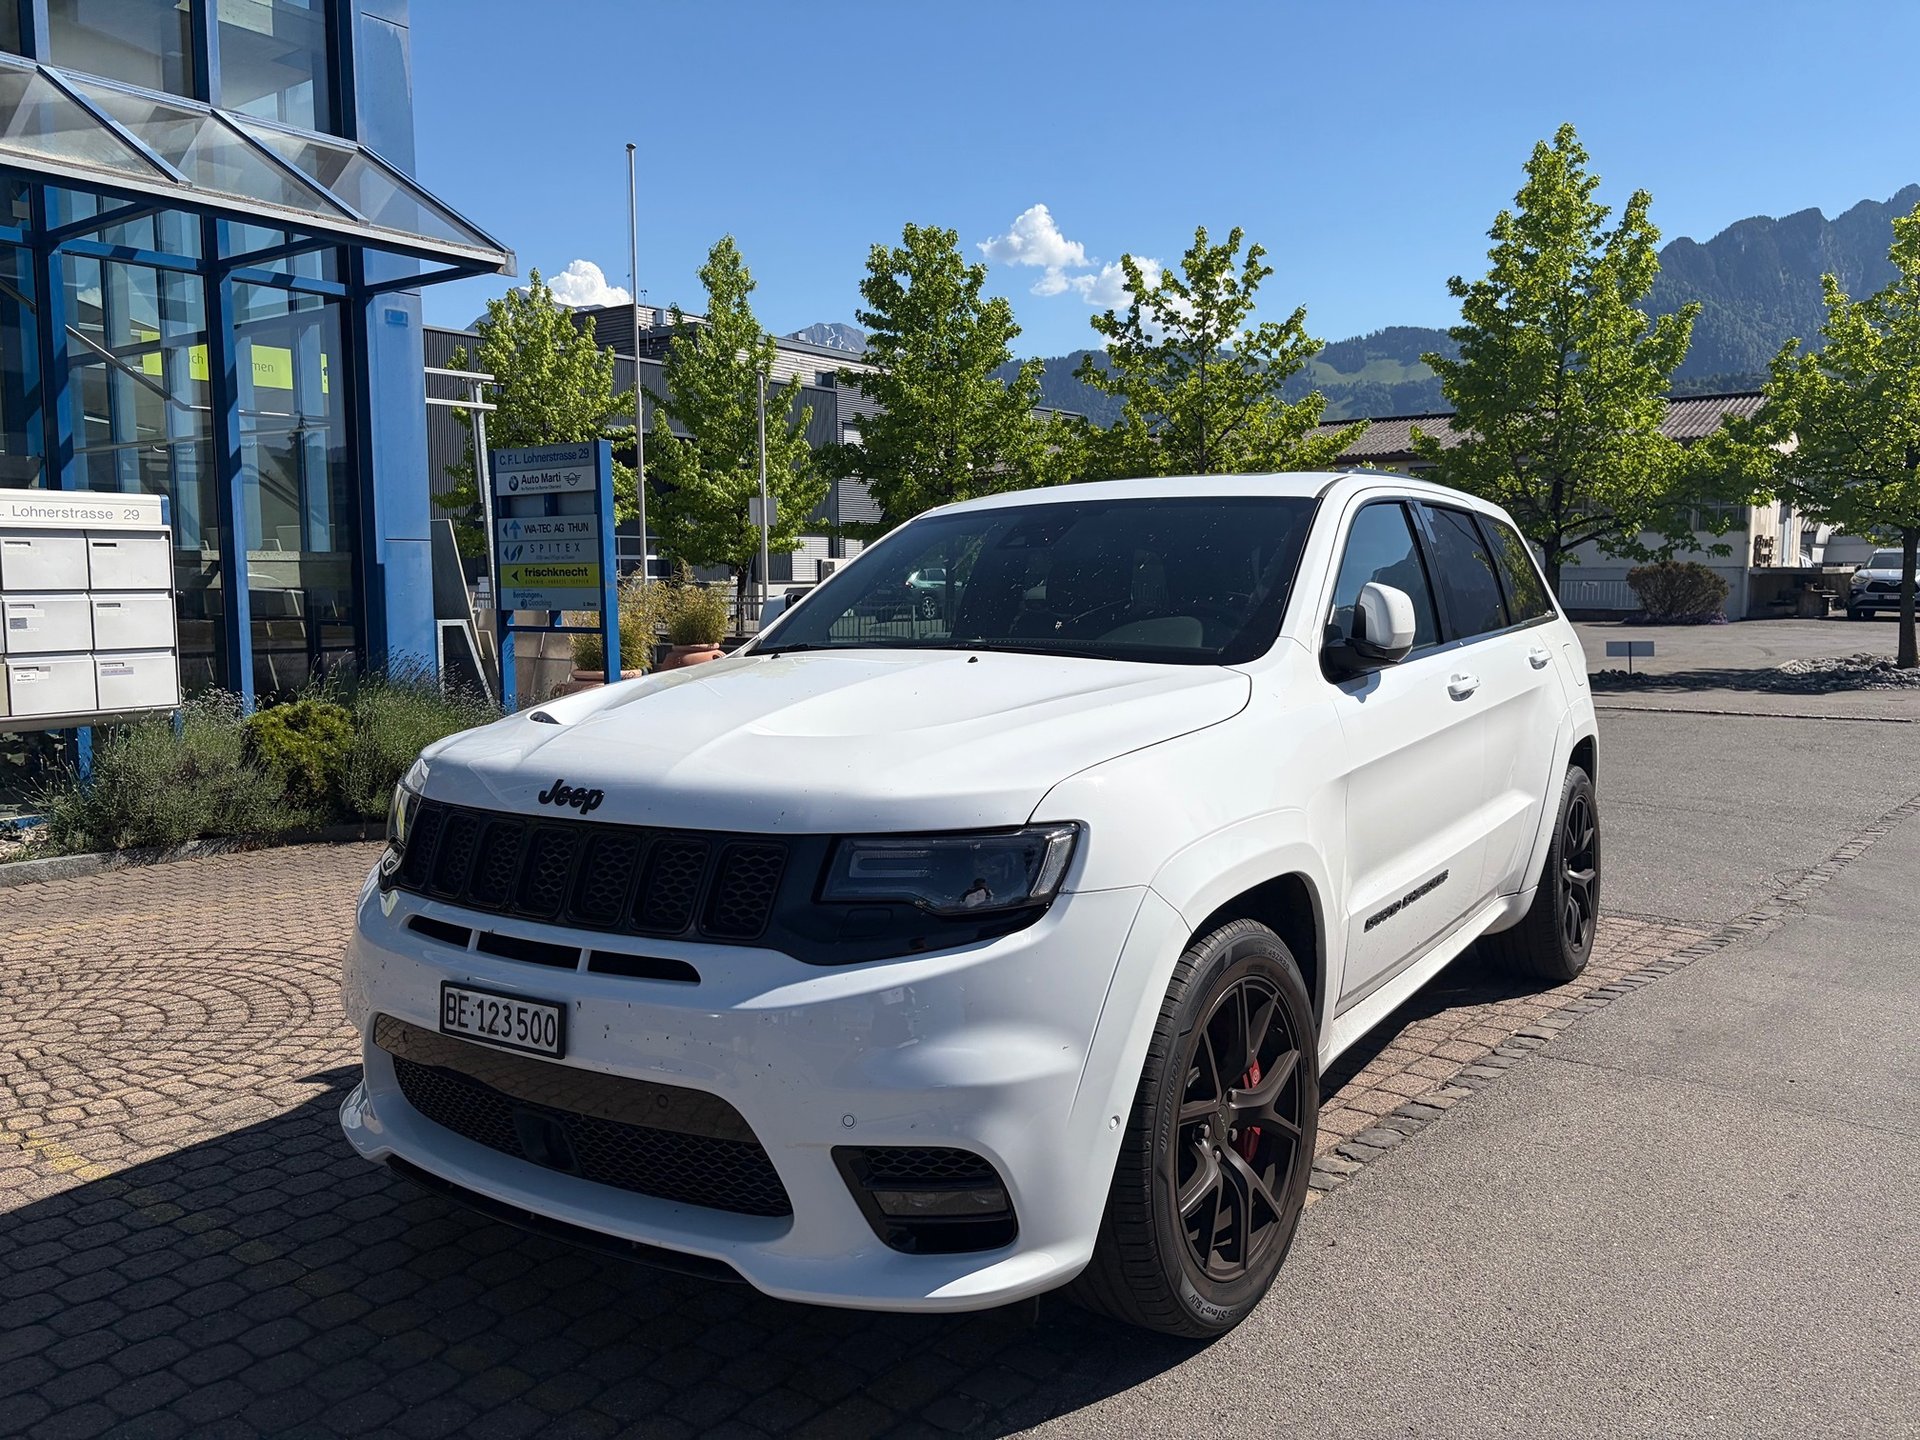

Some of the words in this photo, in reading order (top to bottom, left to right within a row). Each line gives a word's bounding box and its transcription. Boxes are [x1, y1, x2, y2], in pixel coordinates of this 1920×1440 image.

[523, 452, 577, 464] Lohnerstrasse
[578, 447, 590, 459] 29
[521, 474, 540, 485] Auto
[541, 471, 561, 483] Marti
[12, 505, 114, 520] Lohnerstrasse
[123, 509, 140, 520] 29
[524, 524, 552, 534] WA-TEC
[554, 523, 565, 533] AG
[567, 522, 589, 532] THUN
[530, 542, 580, 553] SPITEX
[524, 567, 589, 577] frischknecht
[538, 779, 605, 815] Jeep
